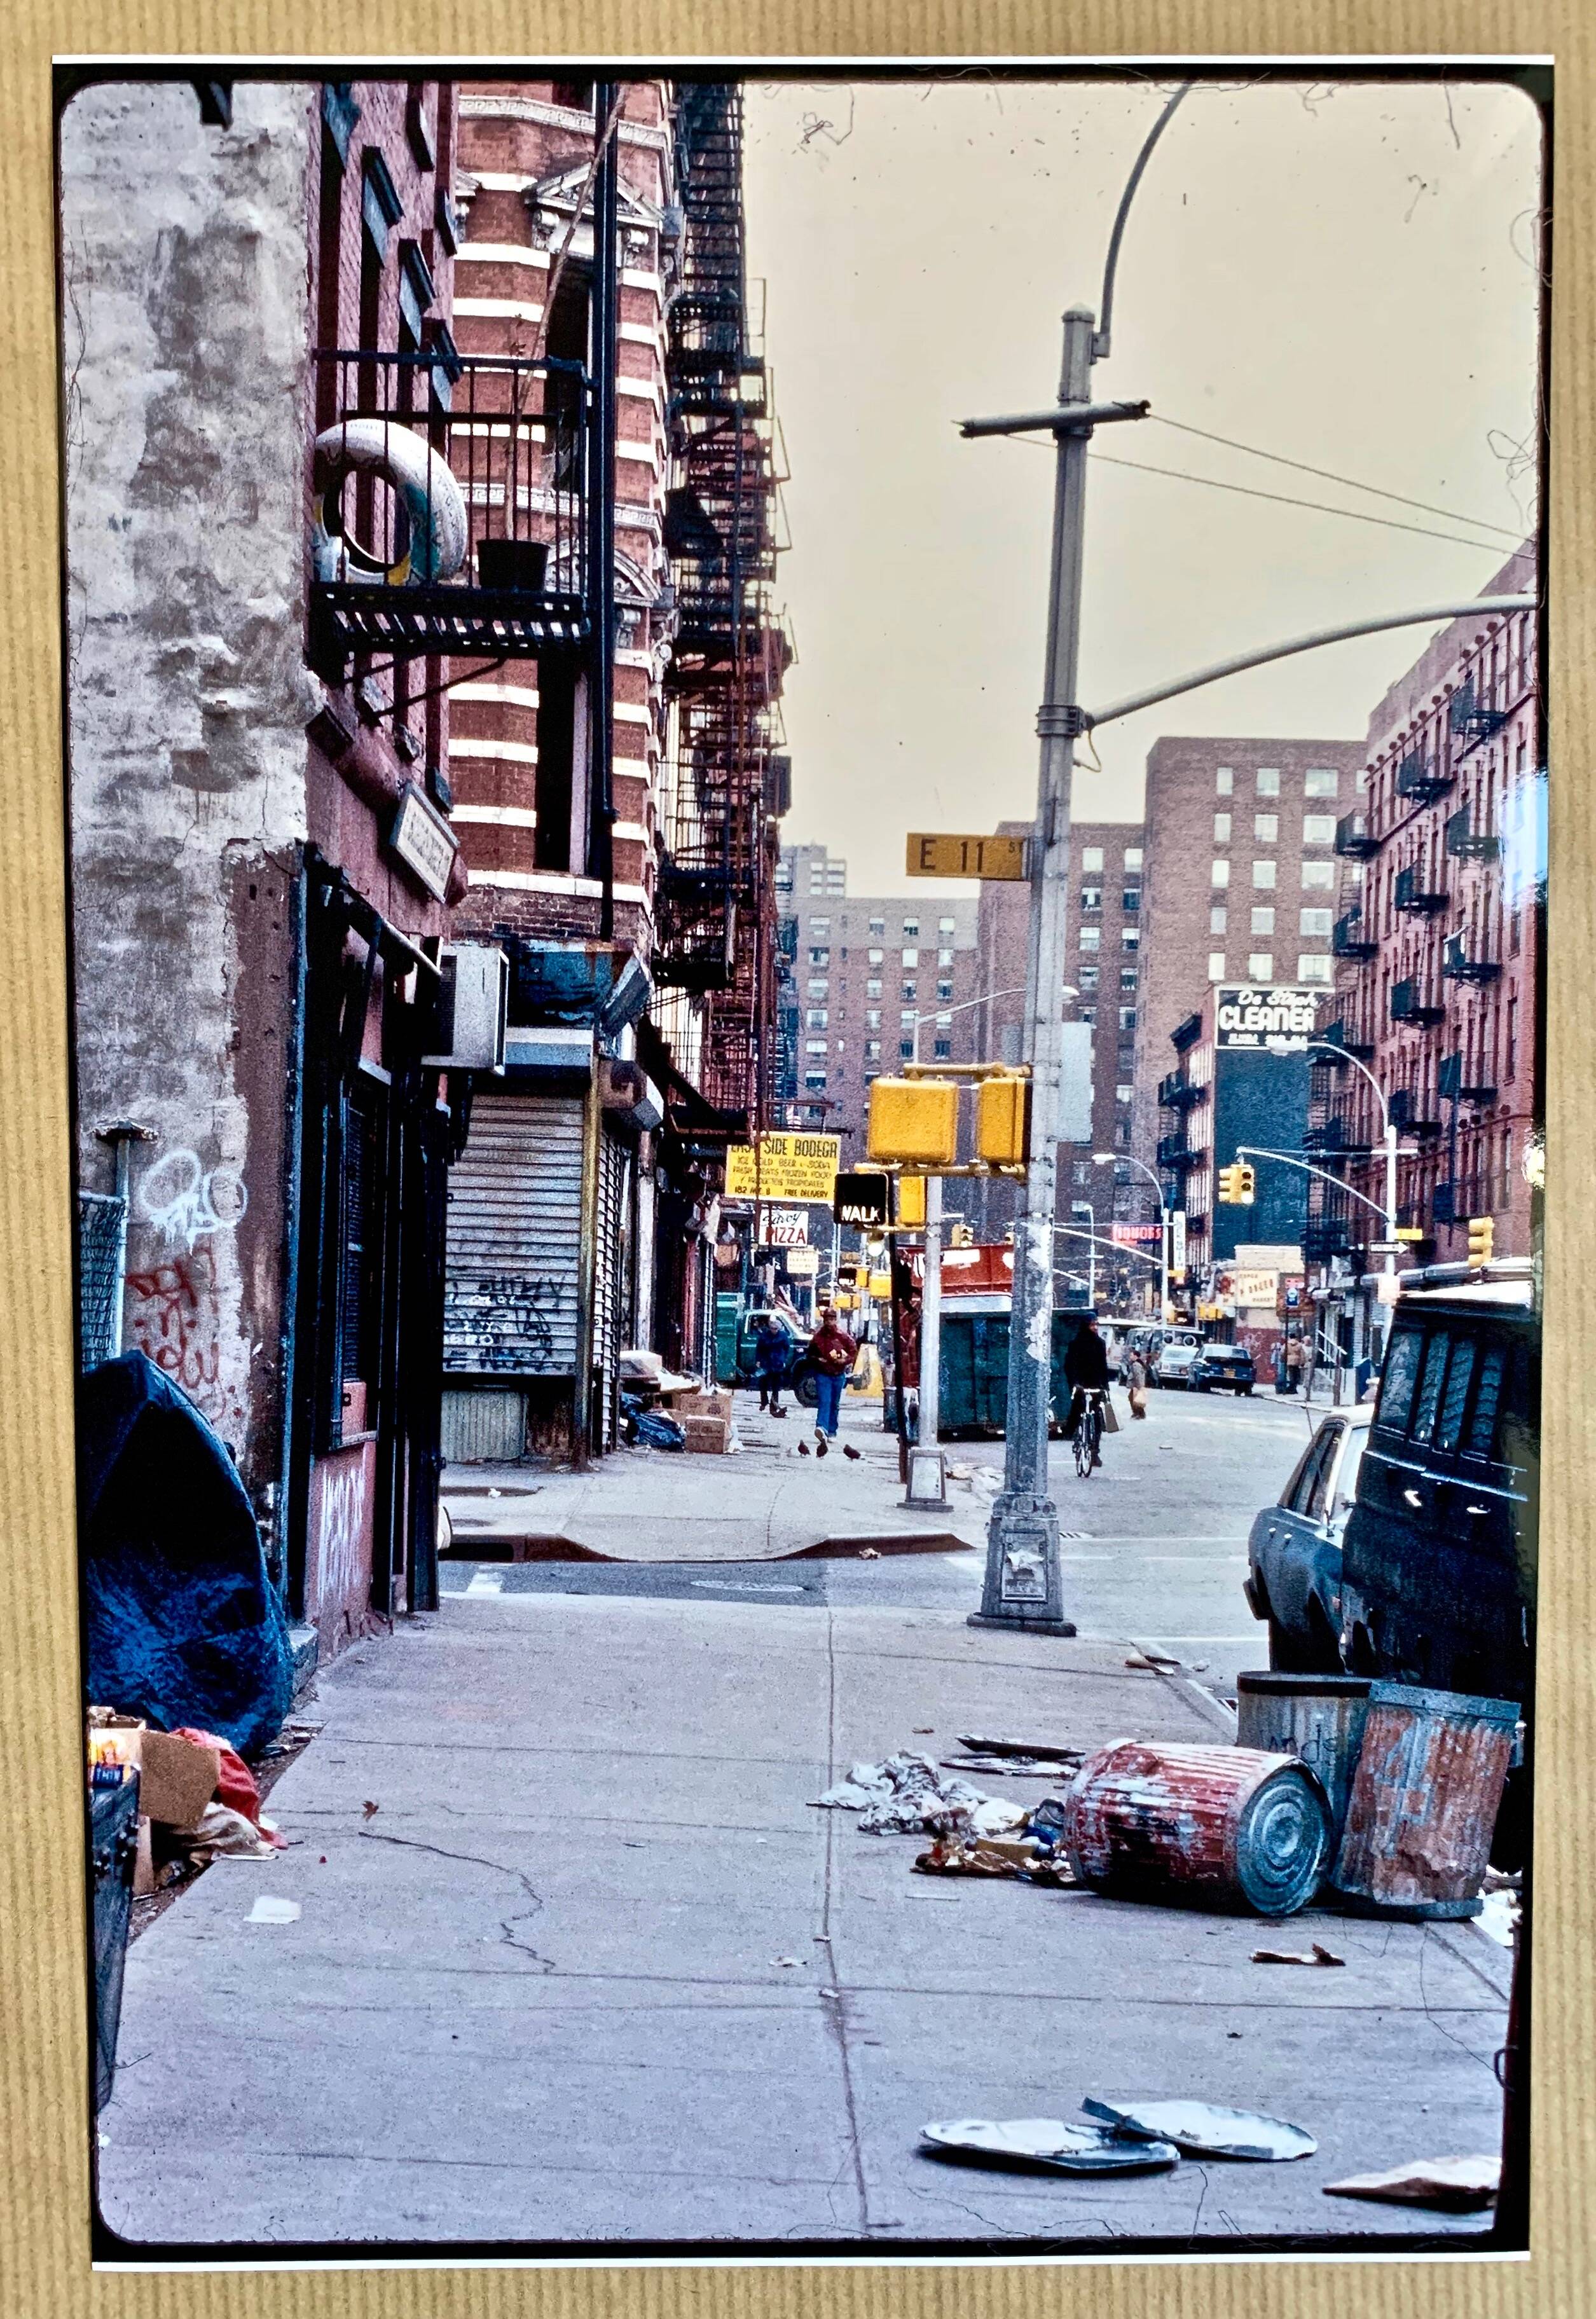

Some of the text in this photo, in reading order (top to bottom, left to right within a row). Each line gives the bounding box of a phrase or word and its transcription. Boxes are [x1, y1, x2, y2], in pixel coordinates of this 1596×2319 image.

[920, 838, 937, 870] E
[960, 841, 984, 872] 11
[764, 1138, 837, 1159] SIDE BODEGA
[841, 1205, 881, 1222] WALK
